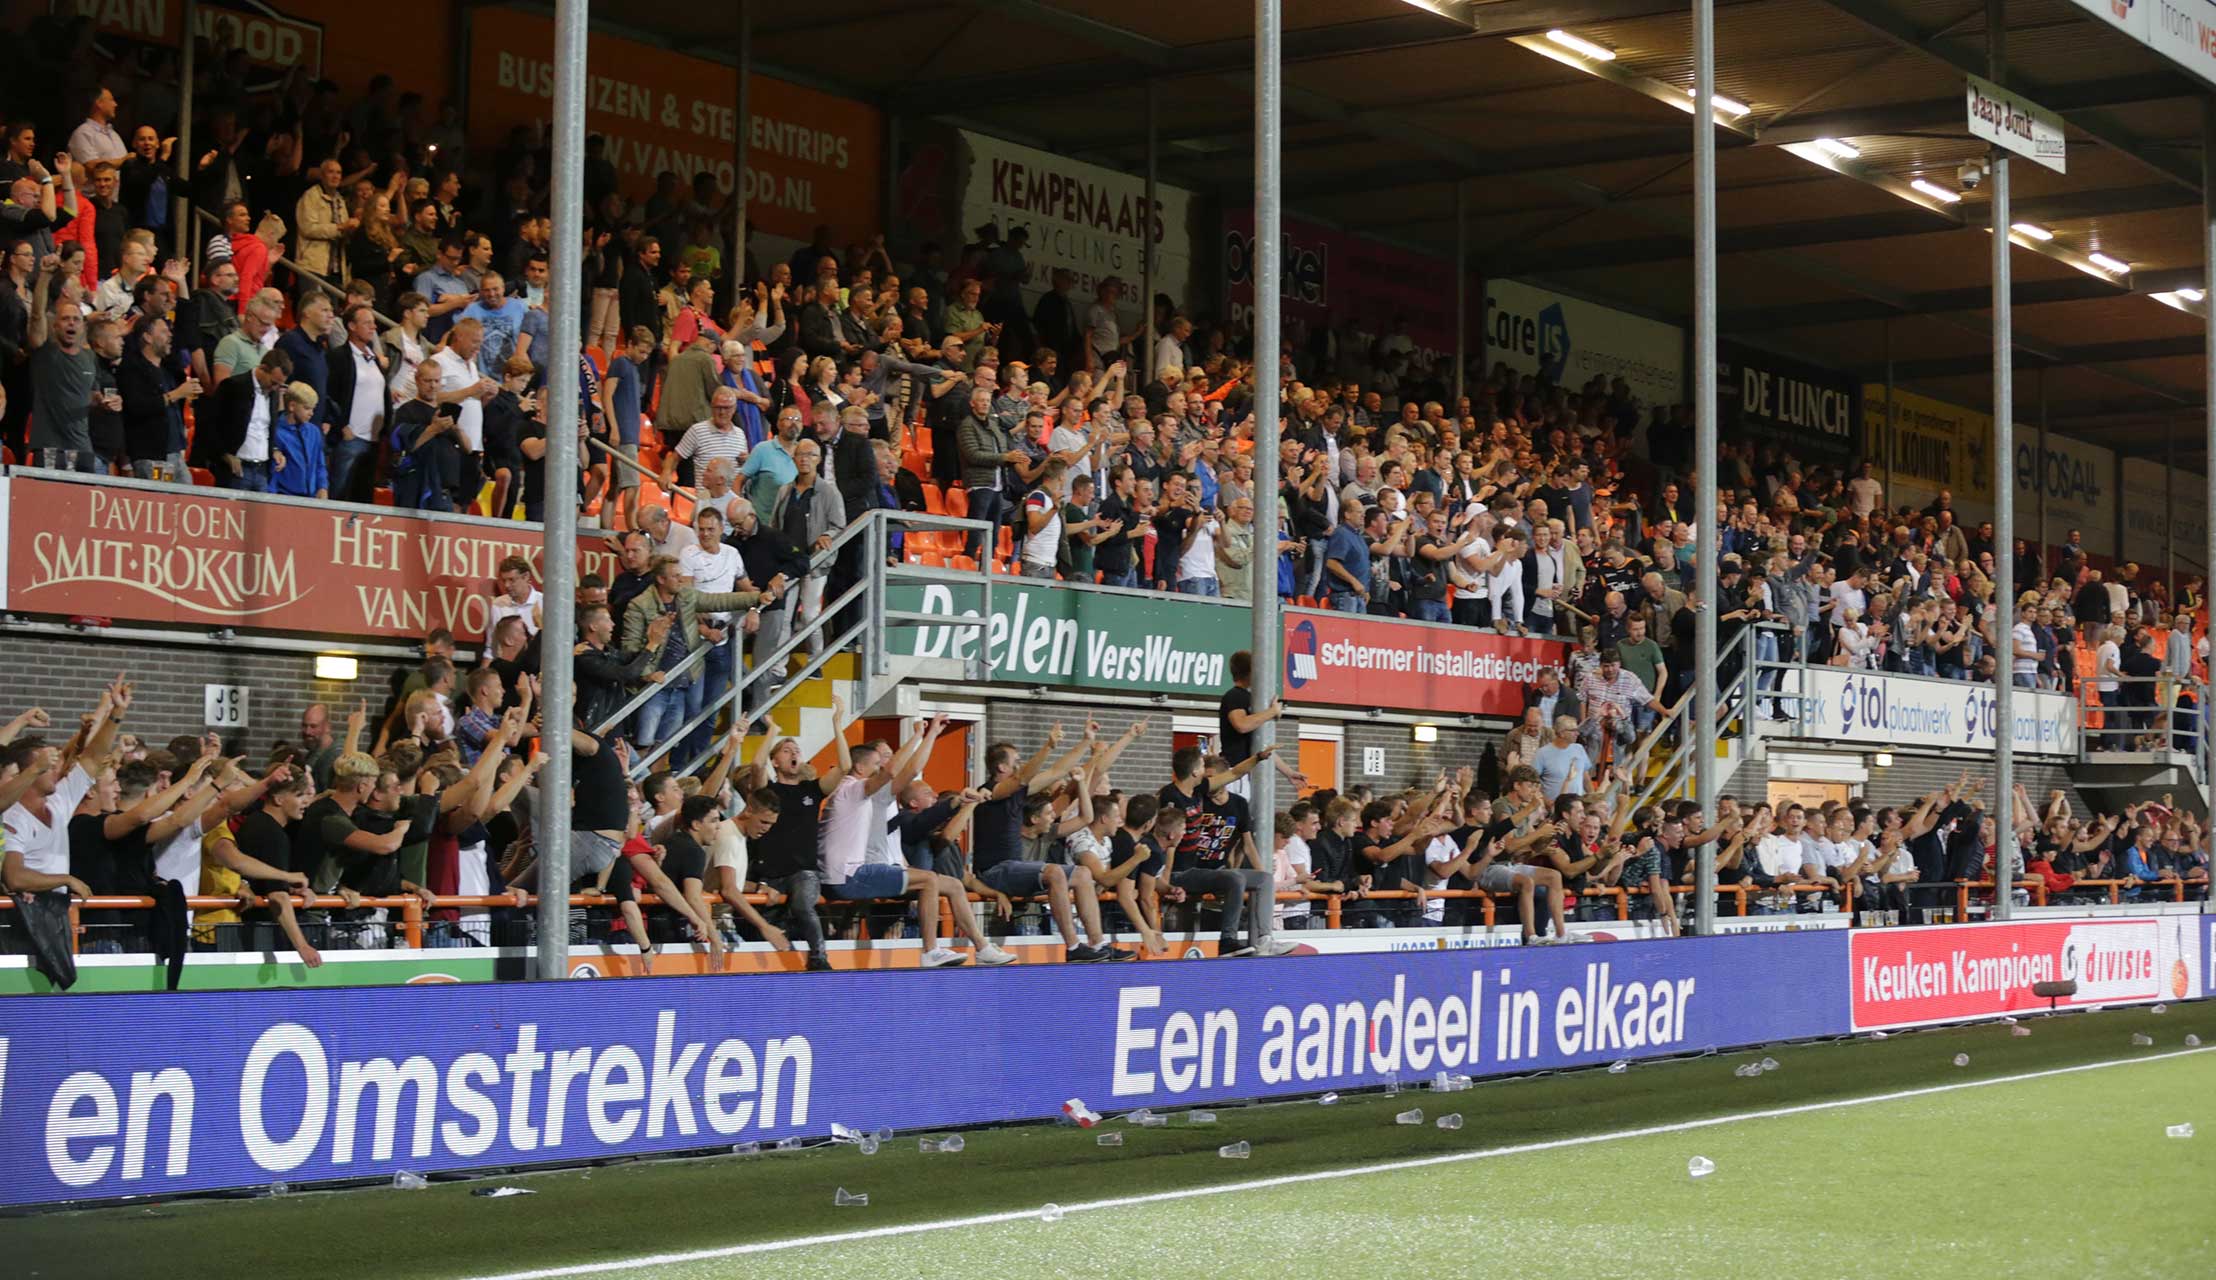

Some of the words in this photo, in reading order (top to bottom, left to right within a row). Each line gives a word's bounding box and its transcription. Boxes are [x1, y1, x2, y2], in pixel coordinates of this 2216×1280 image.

[499, 50, 651, 122] BUSIZEN
[660, 93, 681, 129] &
[992, 158, 1164, 244] KEMPENAARS
[1743, 367, 1772, 417] DE
[1776, 376, 1850, 437] LUNCH
[355, 585, 428, 632] VAN
[914, 584, 1078, 676] Deelen
[1087, 629, 1224, 686] VersWaren
[1321, 638, 1414, 672] schermer
[1859, 677, 1888, 729] tol
[1889, 698, 1951, 738] plaatwerk
[1863, 951, 1947, 1002] Keuken
[1952, 943, 2053, 1001] Kampioen
[2085, 943, 2152, 982] divisie
[1112, 986, 1239, 1096] Een
[1258, 970, 1483, 1085] aandeel
[1497, 968, 1540, 1062] in
[1555, 962, 1695, 1056] elkaar
[45, 1070, 195, 1187] en
[239, 1010, 814, 1172] Omstreken
